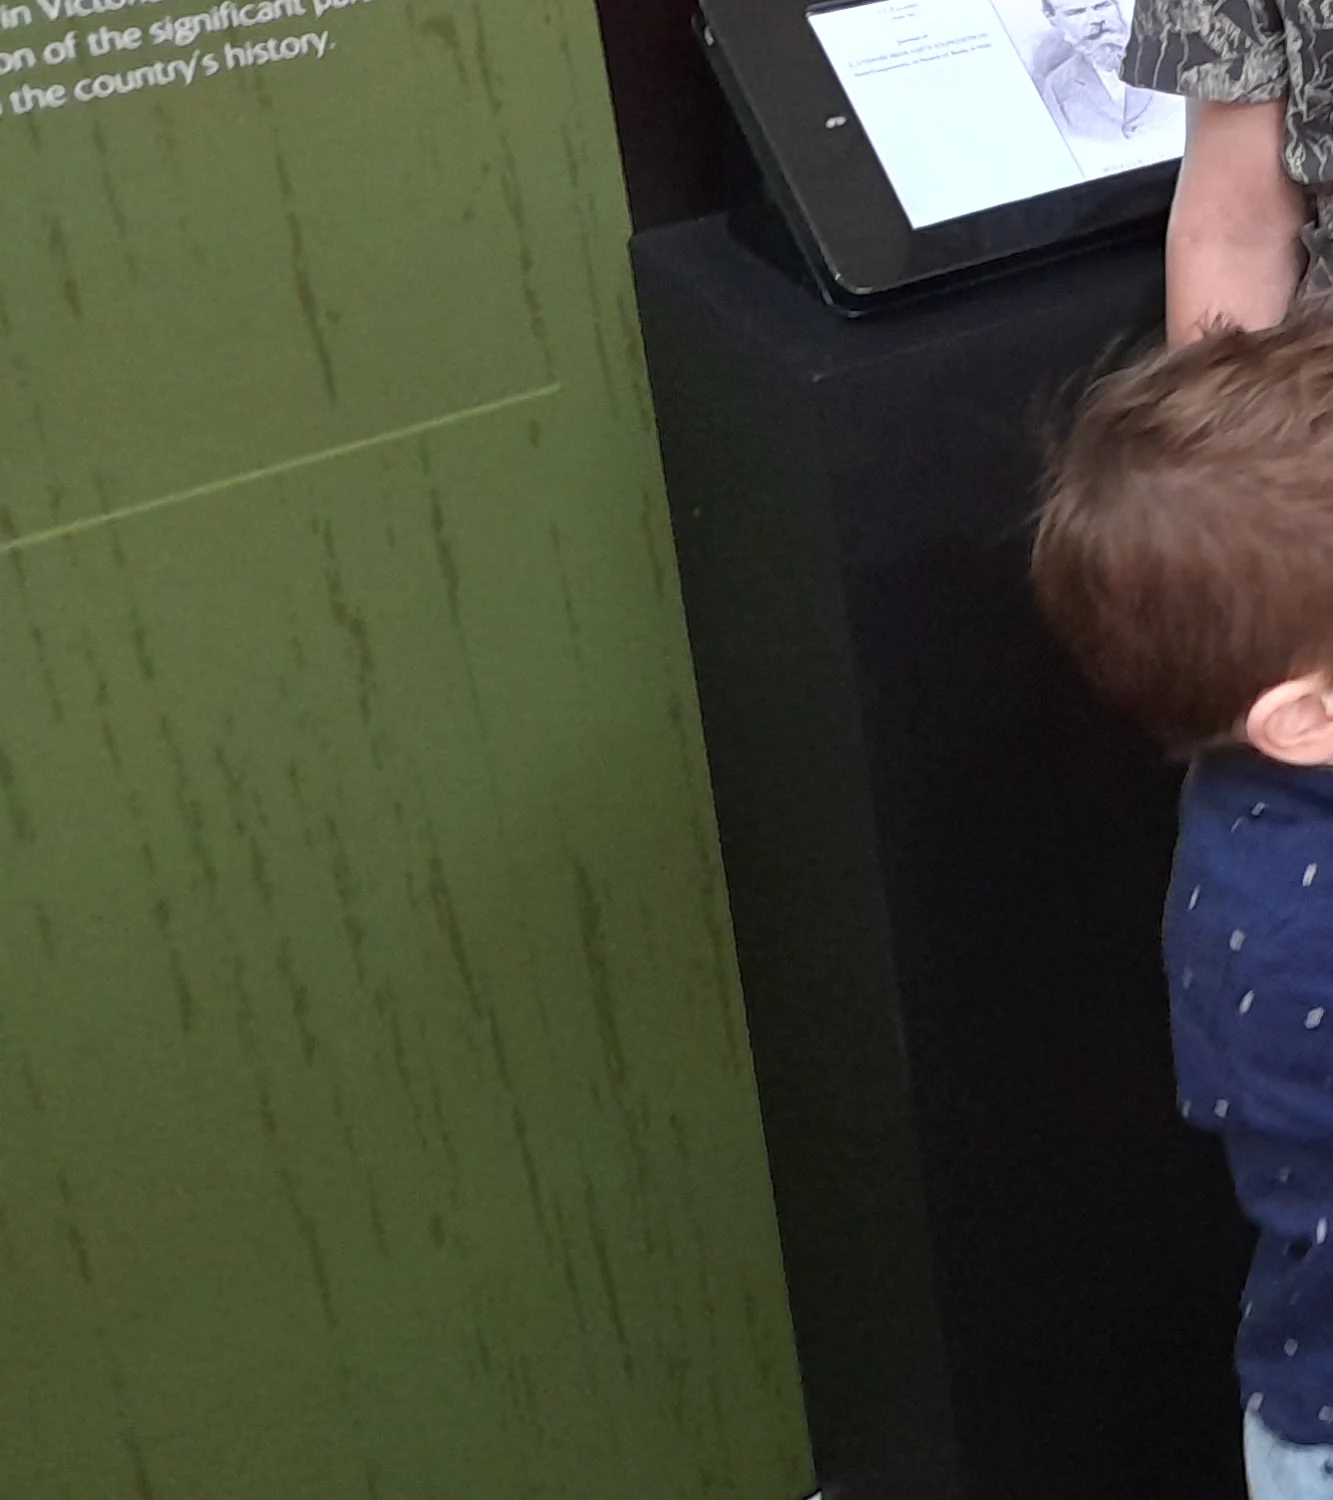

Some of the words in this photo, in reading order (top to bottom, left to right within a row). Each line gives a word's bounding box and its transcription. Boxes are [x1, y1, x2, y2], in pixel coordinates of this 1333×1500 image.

[0, 2, 31, 29] in
[44, 32, 77, 64] of
[88, 25, 142, 57] the
[9, 82, 66, 115] the
[74, 50, 218, 102] country's
[225, 30, 336, 70] history.
